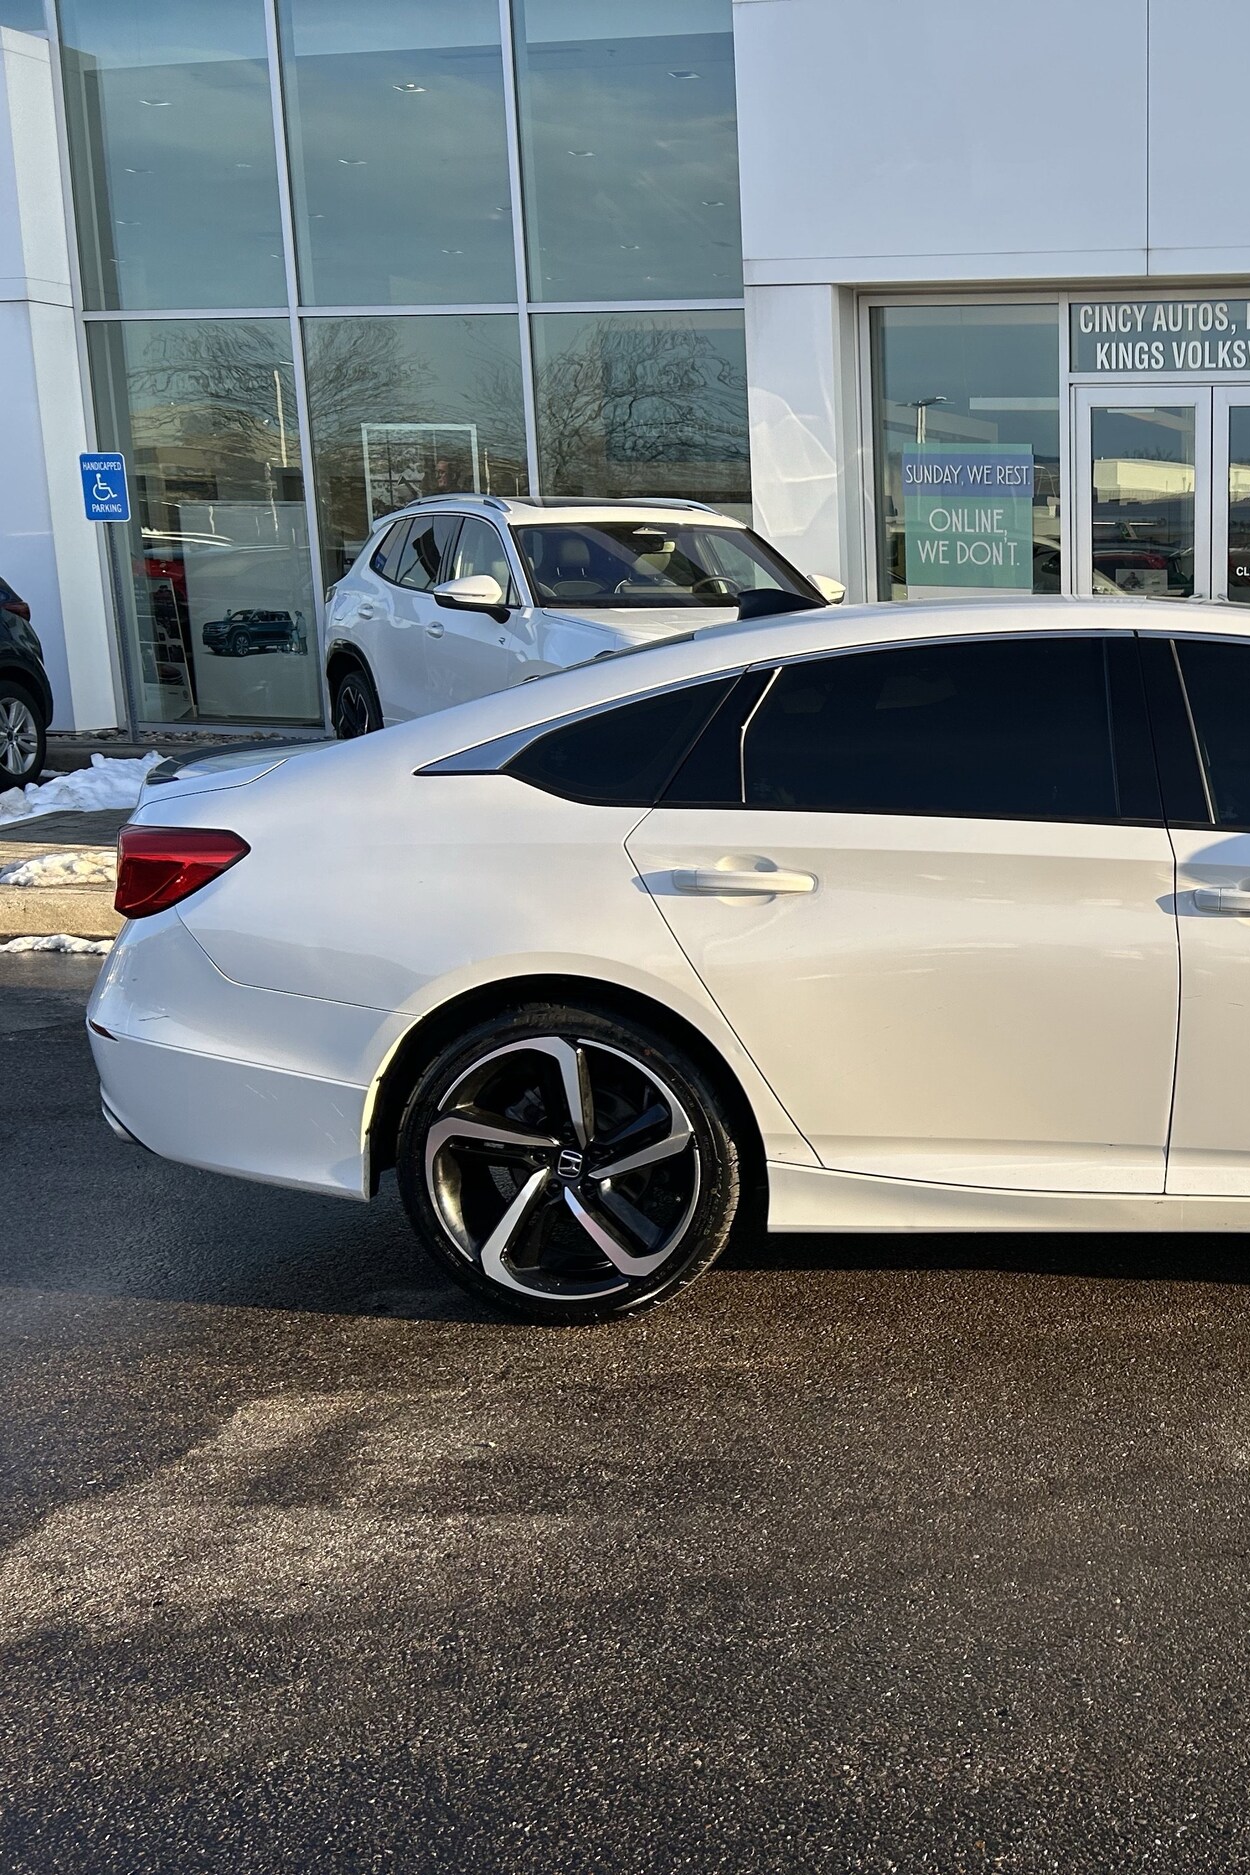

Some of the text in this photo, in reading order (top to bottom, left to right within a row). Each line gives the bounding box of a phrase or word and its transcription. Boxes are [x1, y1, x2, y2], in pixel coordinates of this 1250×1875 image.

[1079, 304, 1147, 333] CINCY
[1152, 302, 1237, 335] AUTOS,
[1096, 341, 1165, 370] KINGS
[82, 461, 122, 471] HANDICAPPED
[905, 464, 1031, 486] SUNDAY, WE REST.
[91, 503, 123, 513] PARKING
[929, 508, 1008, 536] ONLINE,
[917, 537, 1020, 566] WE DON'T.
